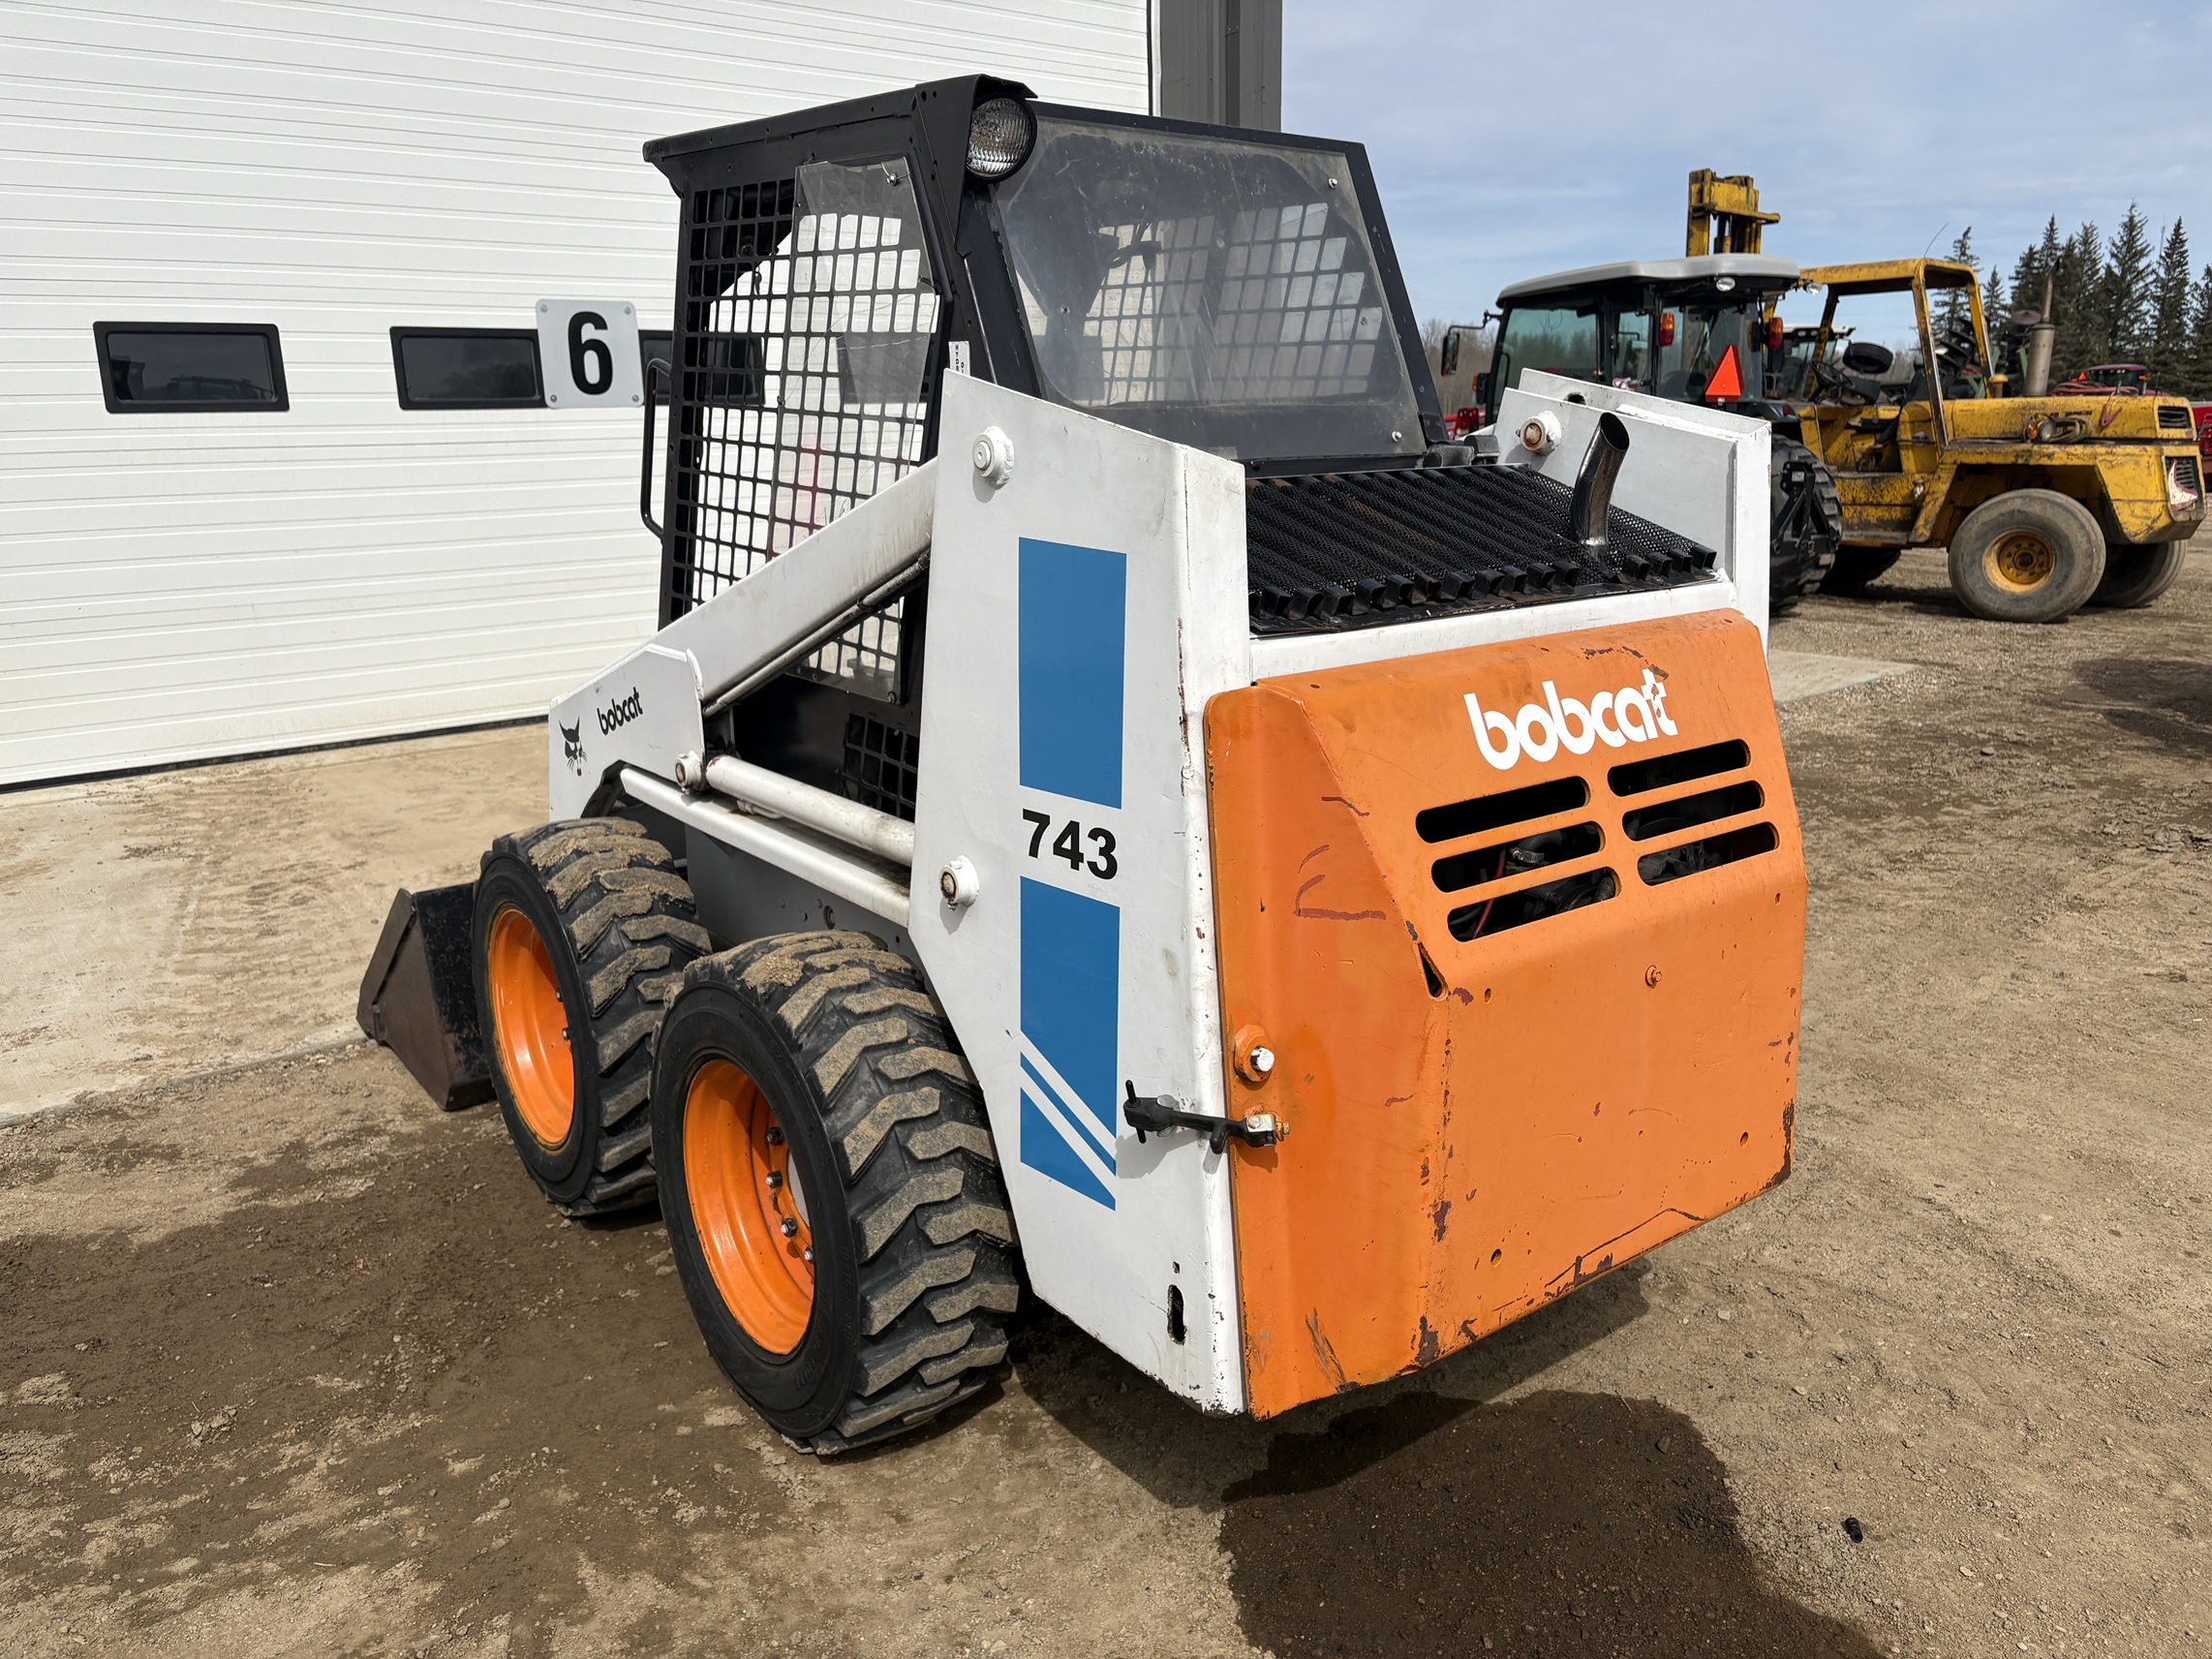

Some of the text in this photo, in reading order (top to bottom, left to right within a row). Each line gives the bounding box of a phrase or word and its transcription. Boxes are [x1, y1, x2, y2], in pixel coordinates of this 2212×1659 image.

[568, 311, 613, 396] 6
[597, 686, 643, 736] bobcat
[1463, 668, 1678, 771] bobcat
[1022, 808, 1119, 880] 743
